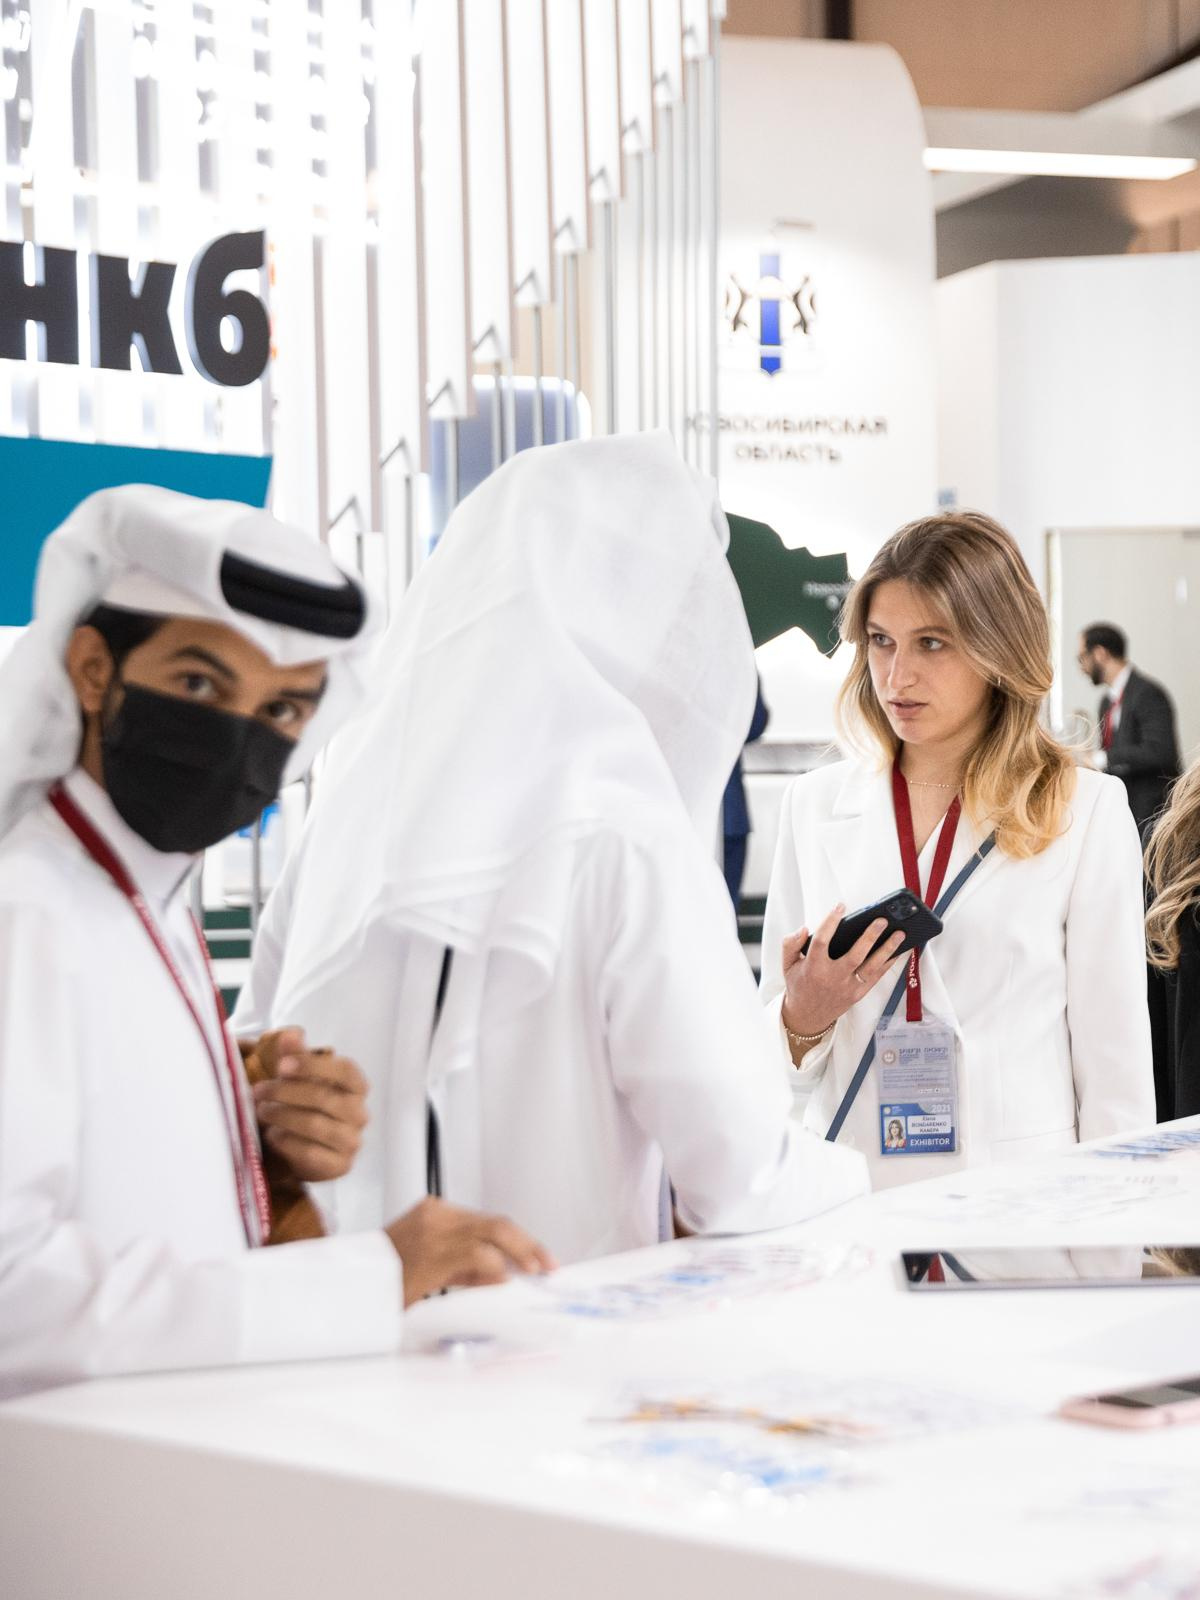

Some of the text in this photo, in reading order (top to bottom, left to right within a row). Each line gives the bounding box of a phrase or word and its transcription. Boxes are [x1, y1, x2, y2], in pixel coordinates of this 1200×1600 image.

[736, 443, 842, 462] ОБЛАСТЬ
[931, 1104, 951, 1113] 2021
[910, 1138, 950, 1146] EXHIBITOR
